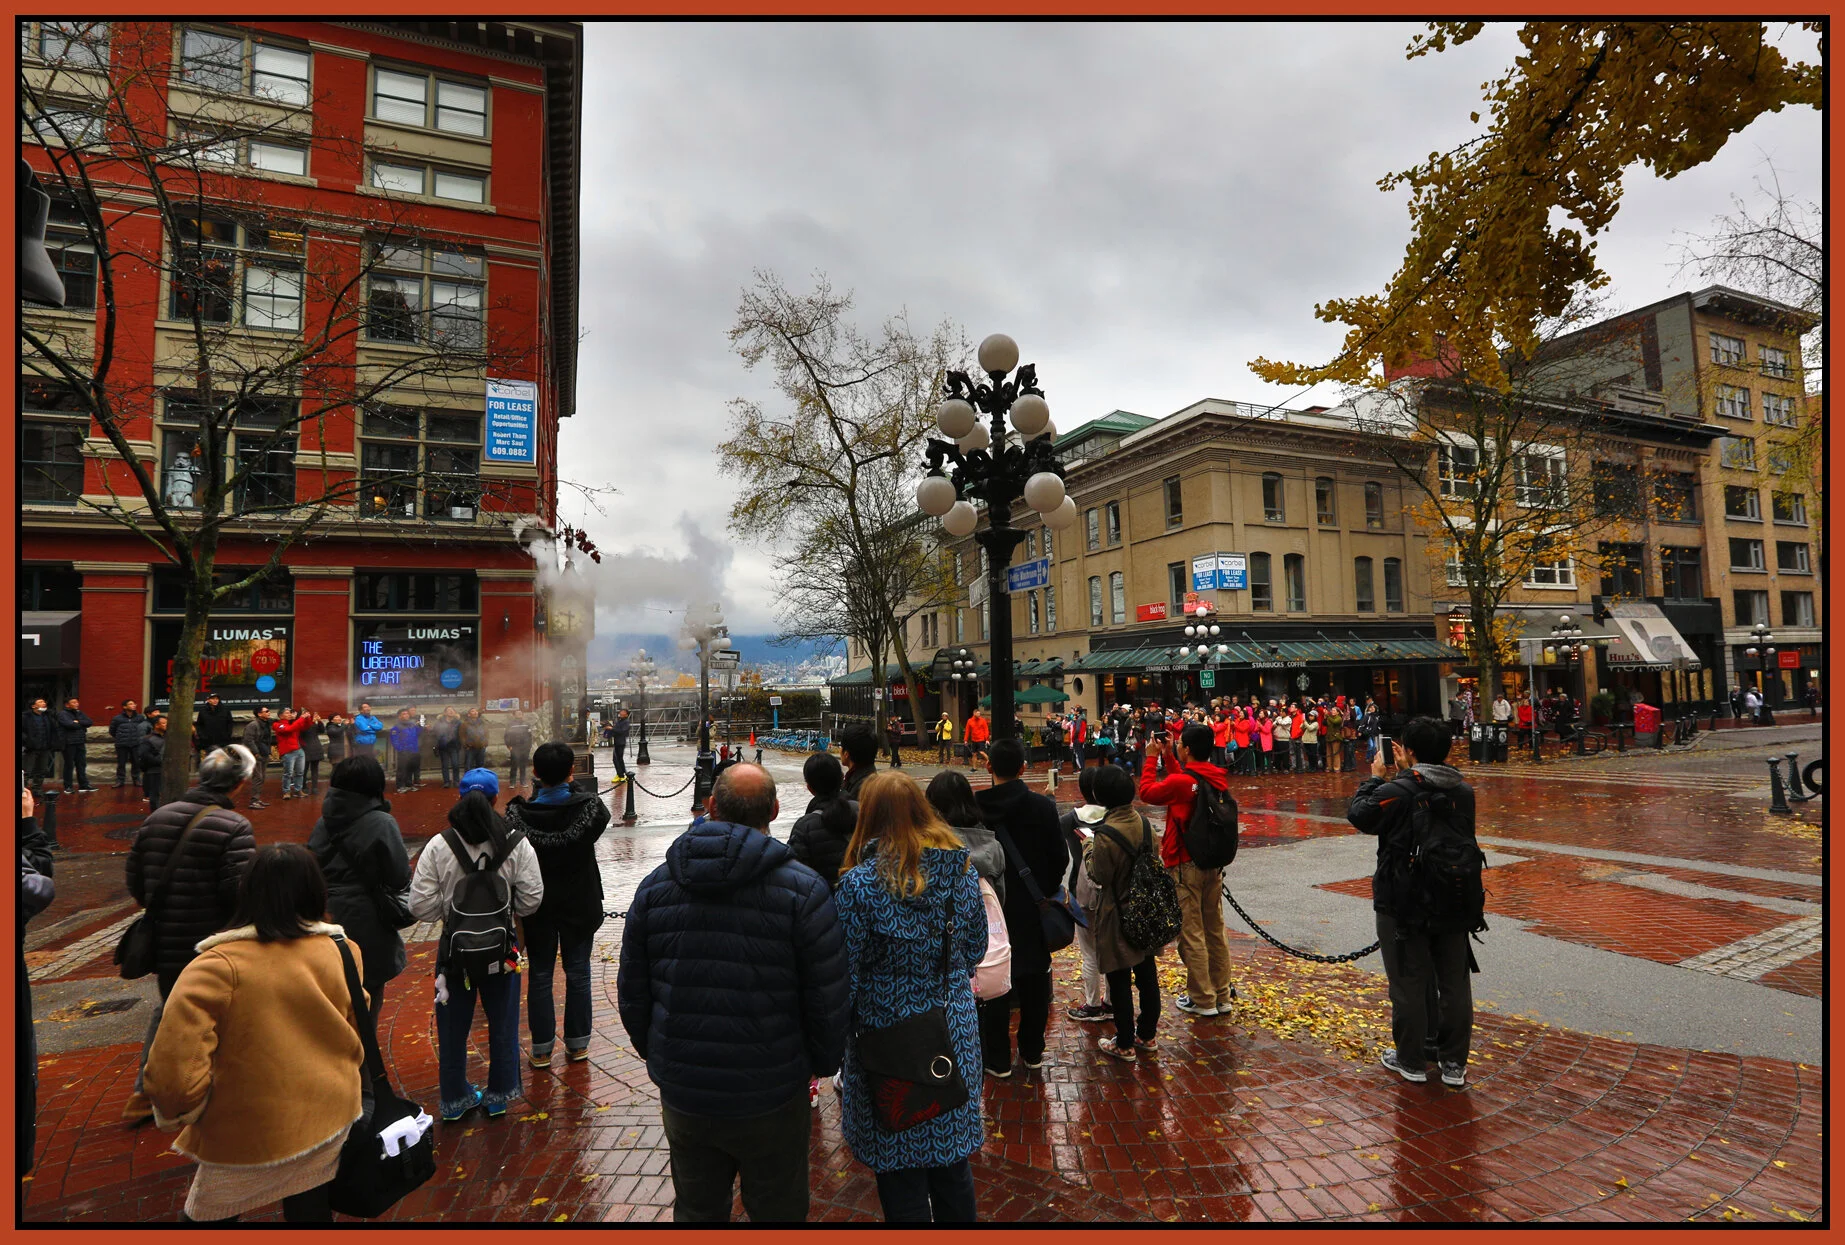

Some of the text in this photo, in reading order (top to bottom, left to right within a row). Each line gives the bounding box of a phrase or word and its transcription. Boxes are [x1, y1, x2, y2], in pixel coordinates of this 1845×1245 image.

[488, 400, 532, 412] FOR LEASE
[491, 420, 529, 429] Opportunities
[495, 438, 510, 446] Marc
[213, 629, 273, 640] LUMAS
[407, 628, 460, 639] LUMAS
[362, 641, 383, 654] THE
[167, 658, 242, 675] VING
[362, 655, 425, 670] LIBERATION
[1251, 661, 1284, 669] STARBUCKS
[362, 671, 401, 685] OF ART
[1202, 678, 1213, 686] EXIT
[893, 685, 906, 696] black
